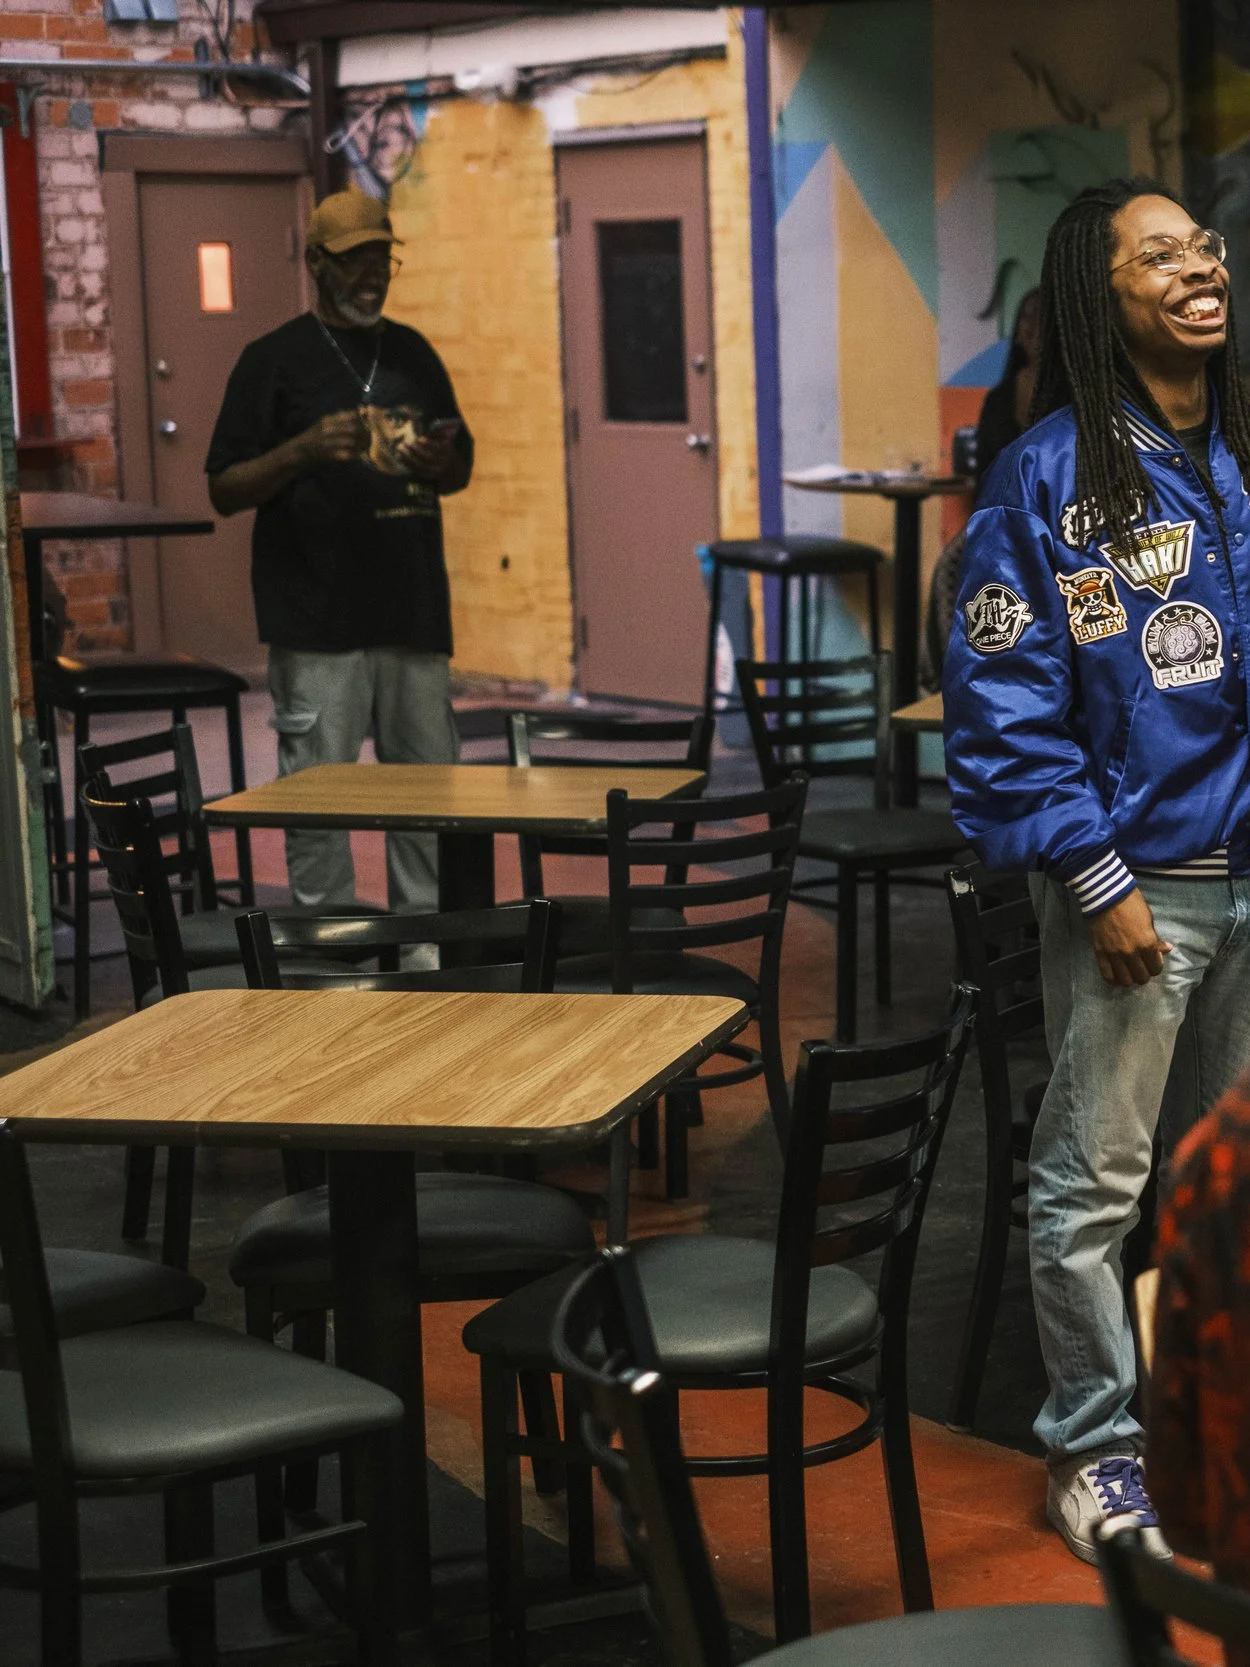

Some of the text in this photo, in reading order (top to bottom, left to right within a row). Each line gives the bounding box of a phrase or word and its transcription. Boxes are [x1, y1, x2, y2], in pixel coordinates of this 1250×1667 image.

[1117, 538, 1185, 583] HAKI
[976, 631, 1012, 645] ONE PIECE
[1077, 614, 1123, 640] LUFFY
[1147, 612, 1218, 655] GUM GUM
[1156, 659, 1220, 685] FRUIT
